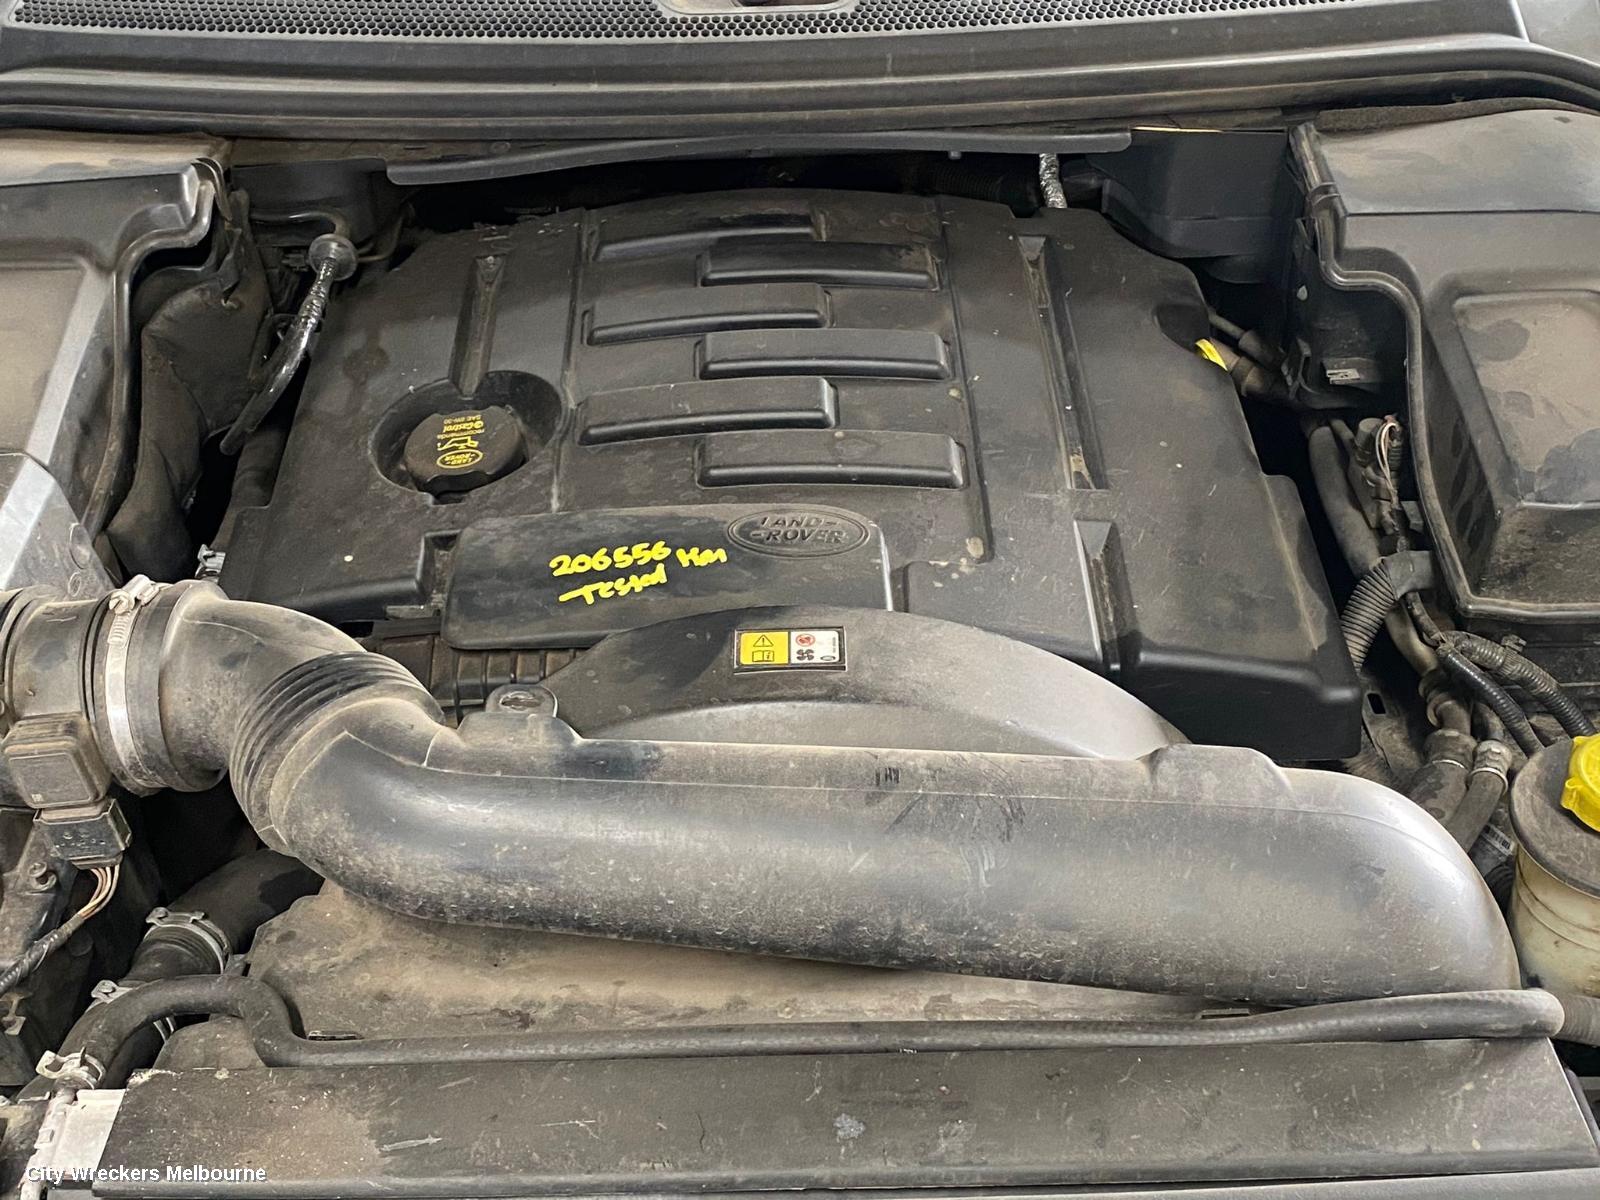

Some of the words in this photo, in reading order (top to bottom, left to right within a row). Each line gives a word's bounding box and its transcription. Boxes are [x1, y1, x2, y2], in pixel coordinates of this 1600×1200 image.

[442, 422, 473, 433] Castrol
[549, 540, 671, 577] 206556
[559, 563, 667, 605] Tested
